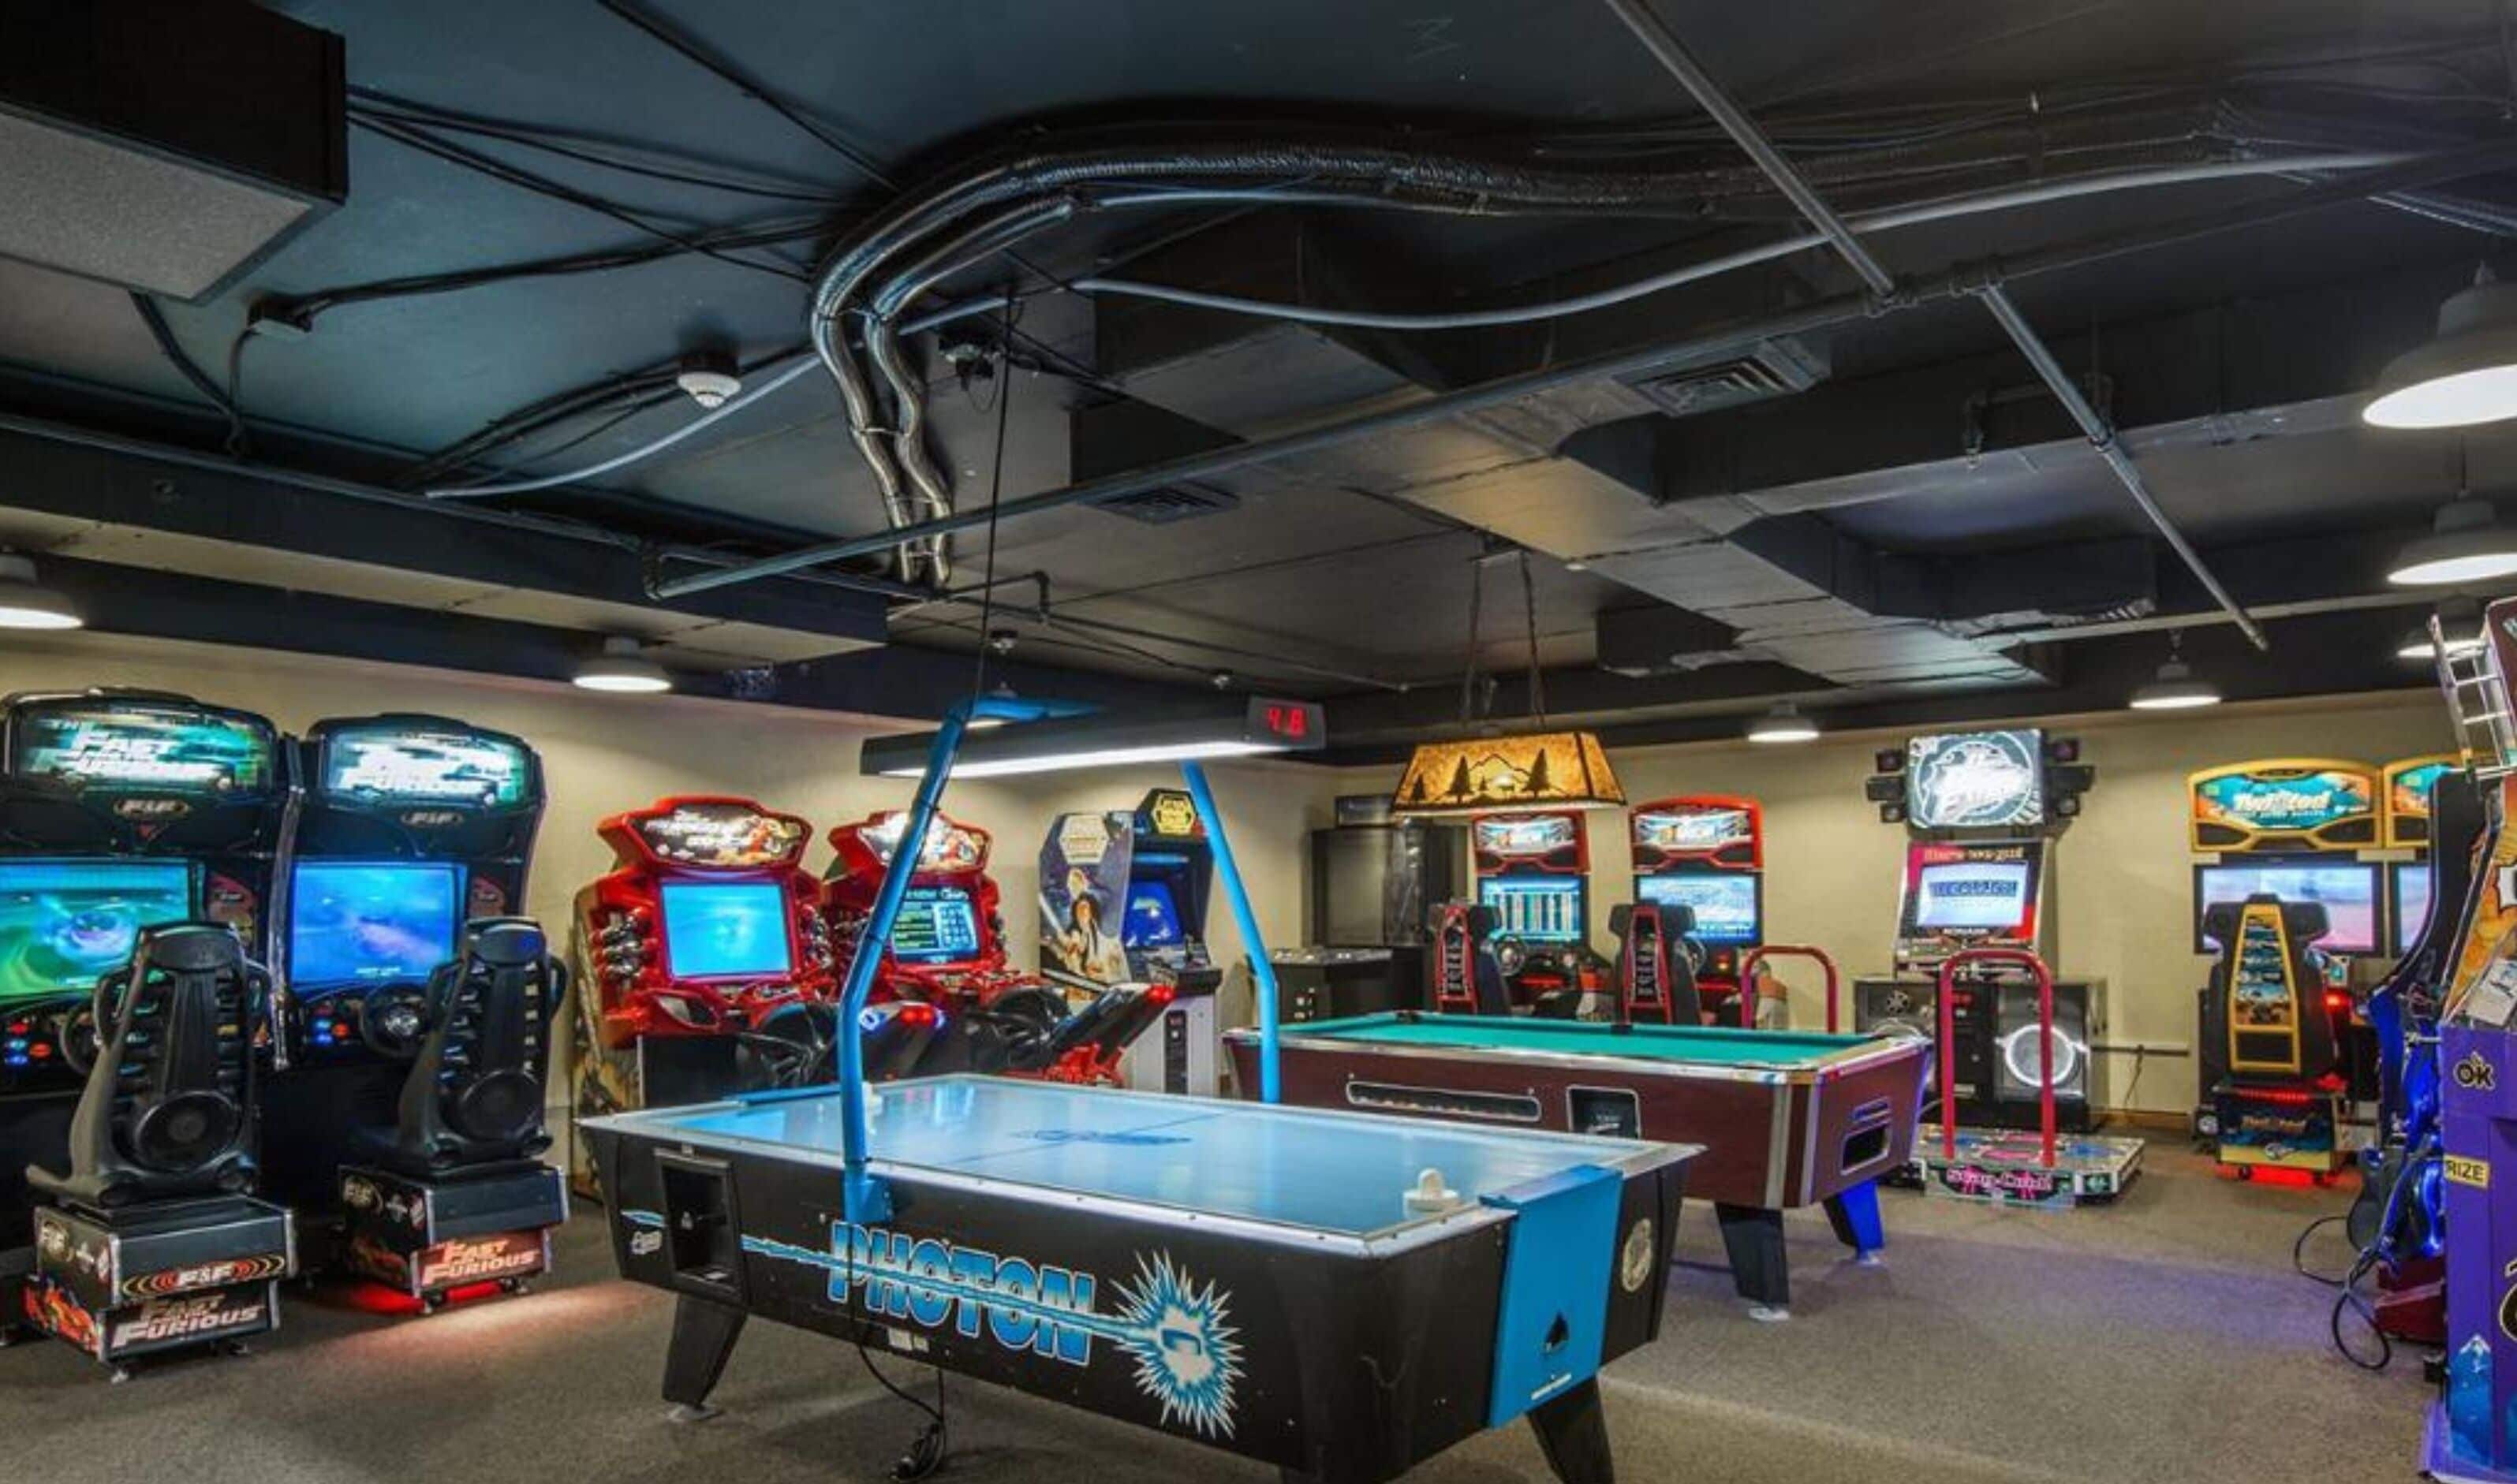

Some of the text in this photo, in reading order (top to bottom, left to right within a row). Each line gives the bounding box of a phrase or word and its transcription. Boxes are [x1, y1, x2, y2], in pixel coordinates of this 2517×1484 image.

[2453, 1060, 2496, 1091] OK
[177, 1263, 233, 1289] F&F
[421, 1248, 542, 1287] FURIOUS
[827, 1219, 1098, 1367] PHOTON
[112, 1305, 266, 1348] FURIOUS
